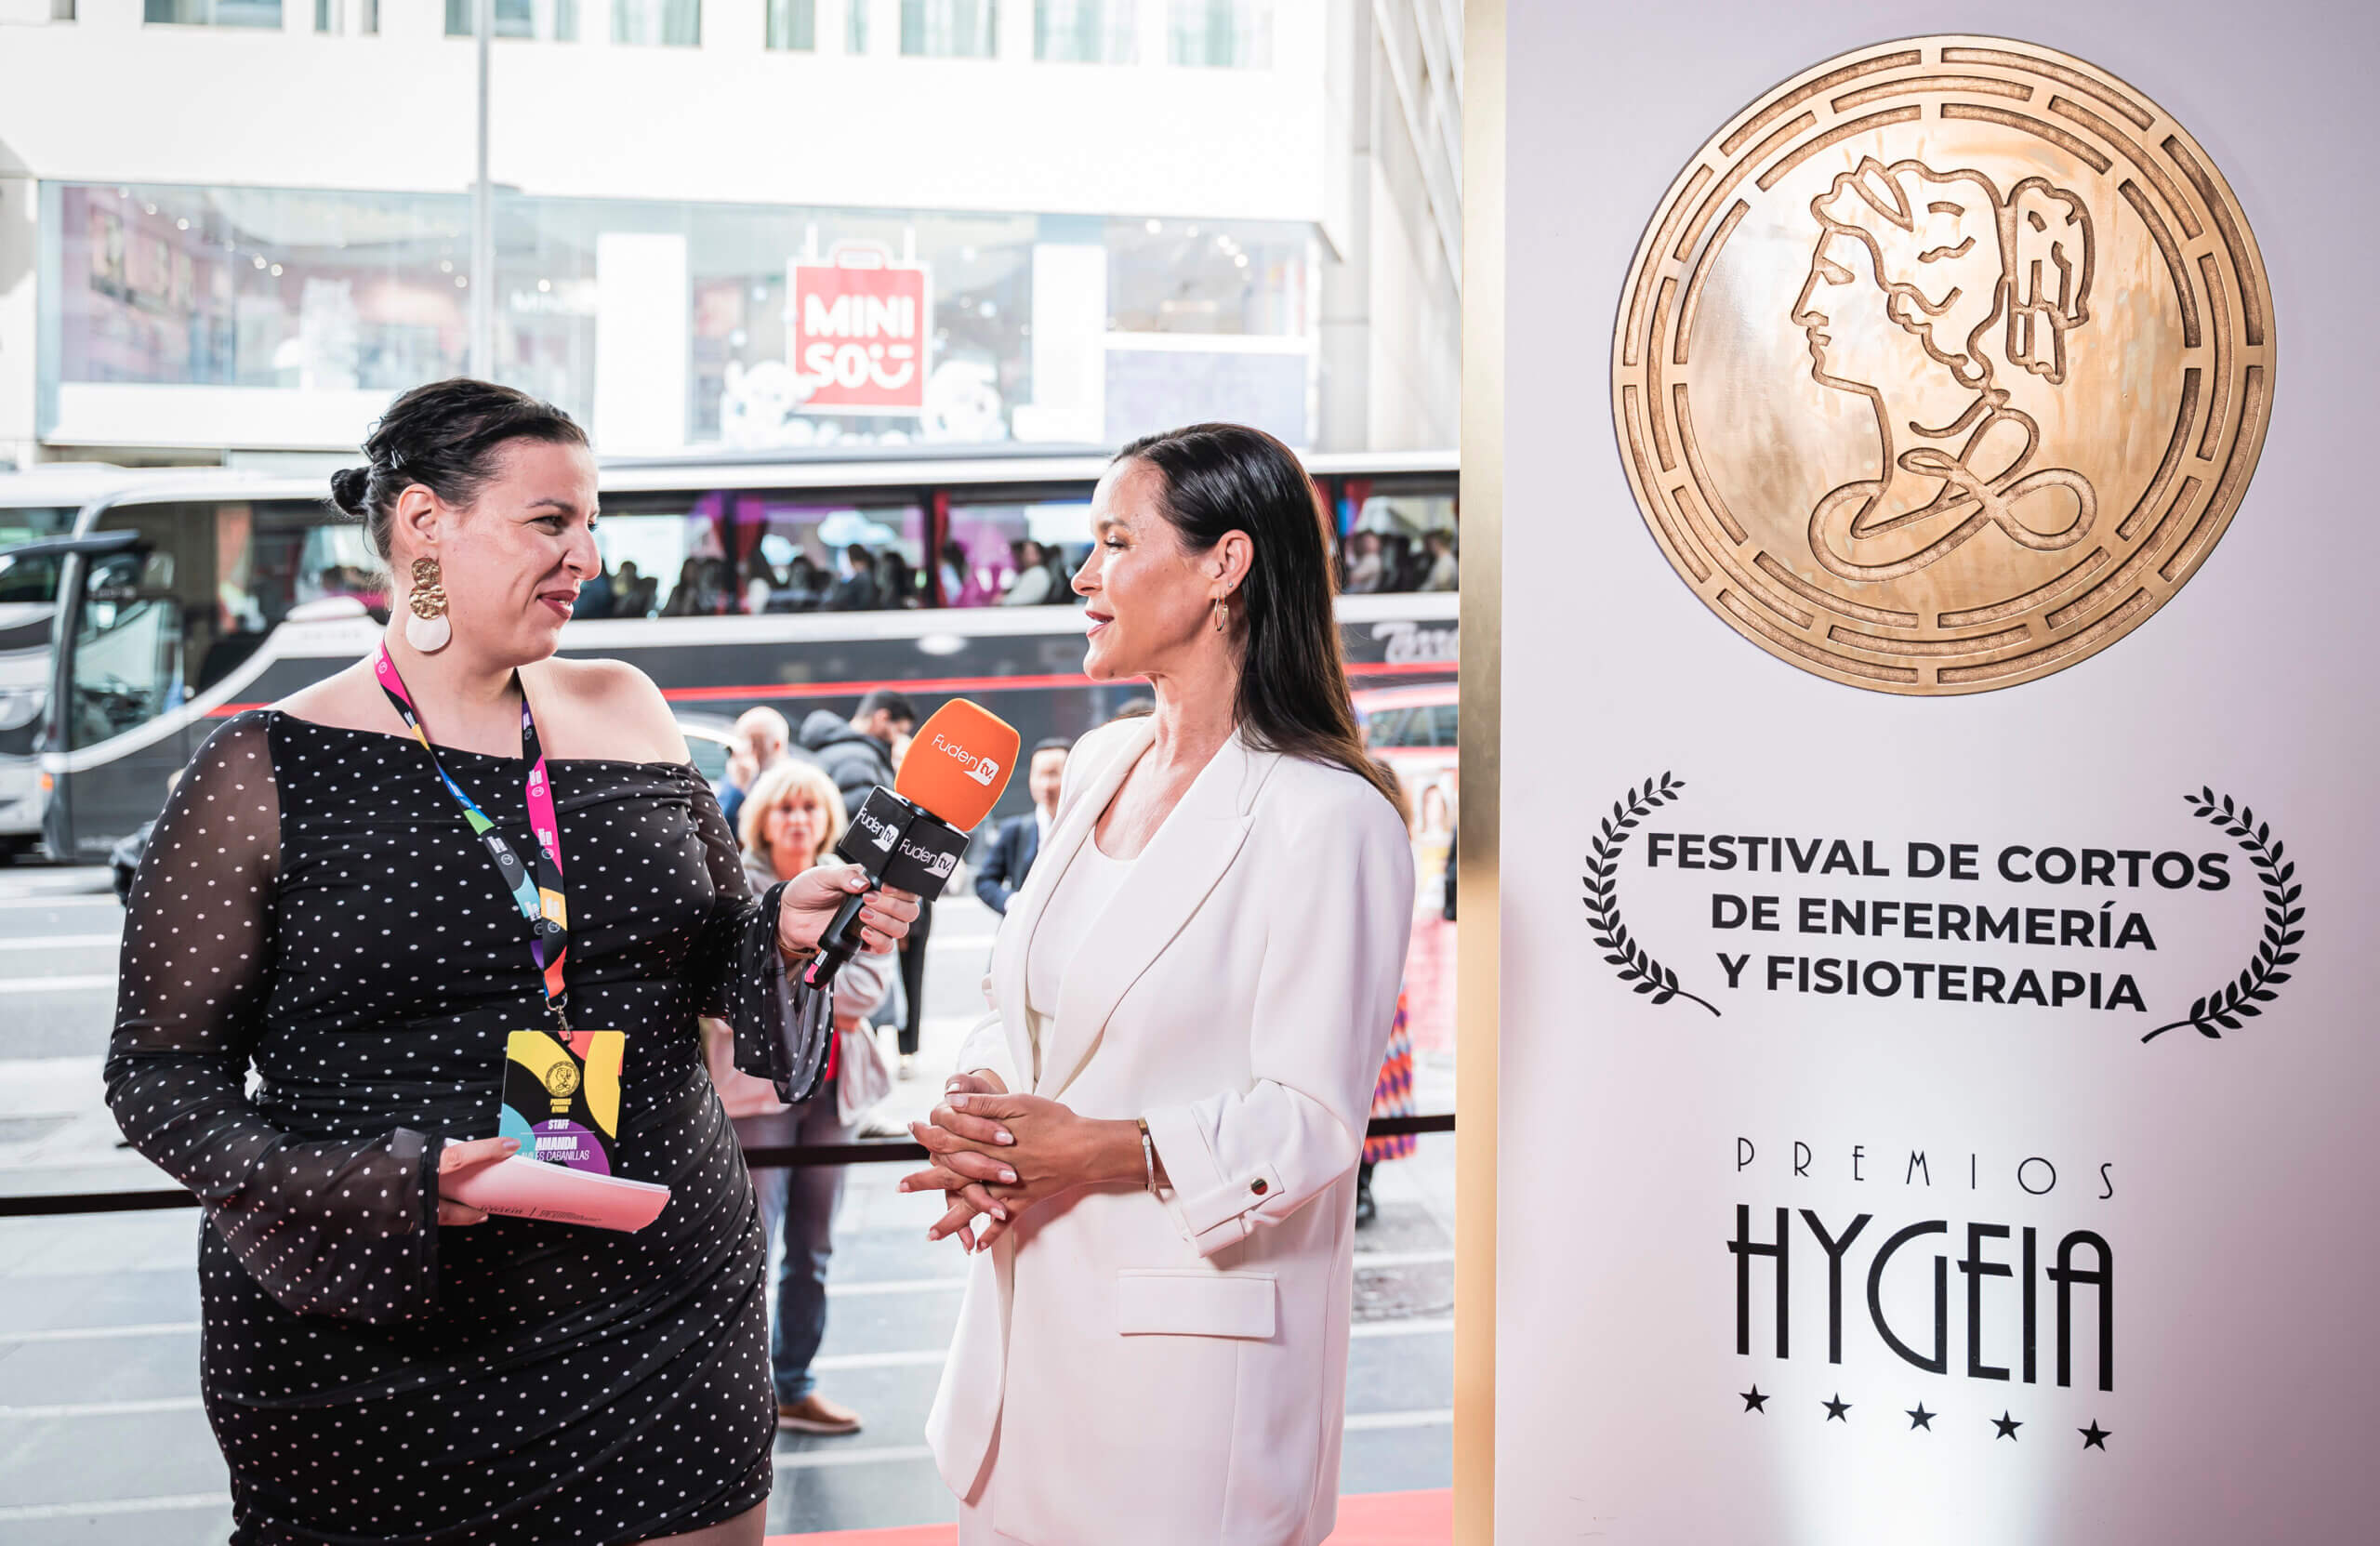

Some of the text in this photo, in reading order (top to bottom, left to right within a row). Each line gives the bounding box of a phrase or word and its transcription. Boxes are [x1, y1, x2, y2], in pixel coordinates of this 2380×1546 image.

[804, 294, 915, 338] MINI
[931, 733, 978, 770] Fuden
[856, 807, 885, 838] Fuden
[898, 839, 938, 866] Fuden
[1648, 832, 2231, 892] FESTIVAL DE CORTOS
[1712, 894, 2158, 951] DE ENFERMERÍA
[1717, 953, 2148, 1012] Y FISIOTERAPIA
[536, 1136, 577, 1151] AMANDA
[548, 1118, 570, 1130] STAFF
[546, 1150, 590, 1161] CABANILLAS
[1738, 1137, 2113, 1200] PREMIOS
[1726, 1204, 2113, 1393] HYGEIA
